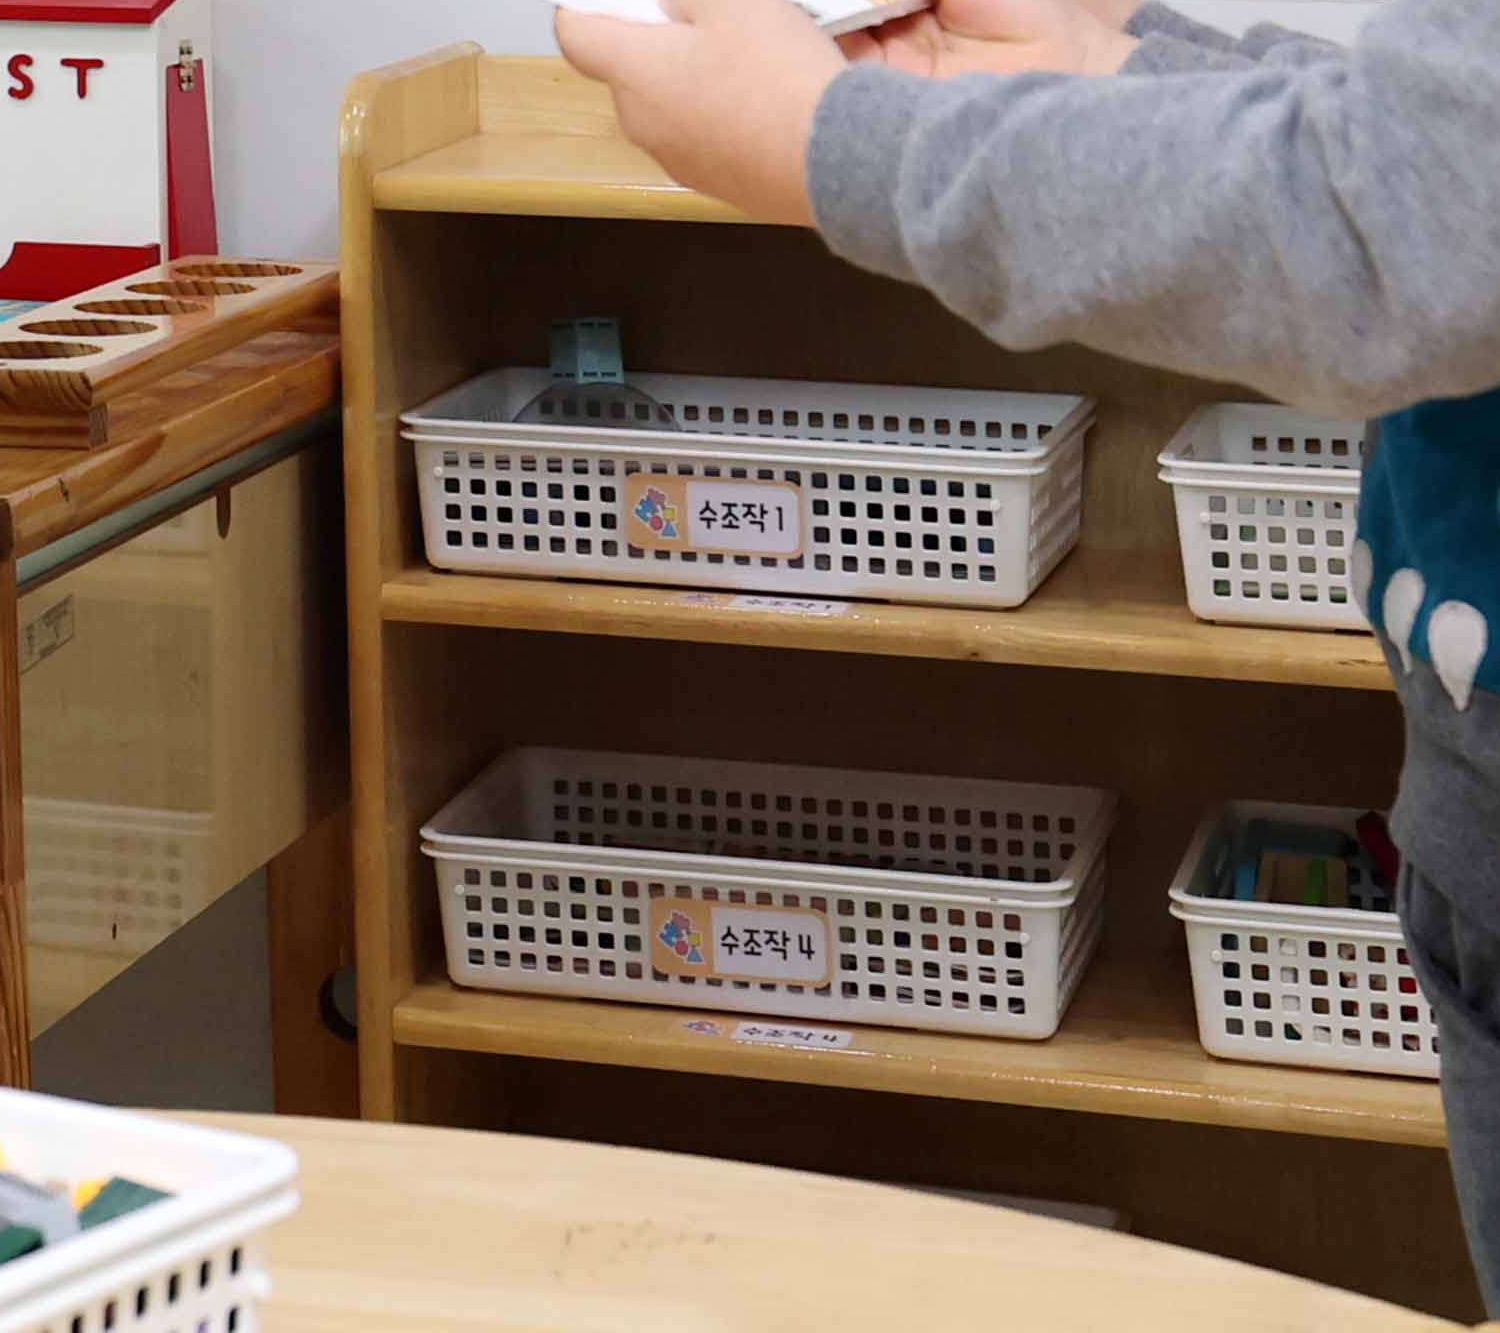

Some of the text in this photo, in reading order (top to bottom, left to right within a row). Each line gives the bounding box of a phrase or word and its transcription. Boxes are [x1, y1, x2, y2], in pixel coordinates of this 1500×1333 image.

[698, 499, 784, 534] 수조작 1
[720, 924, 816, 961] 수조작 4
